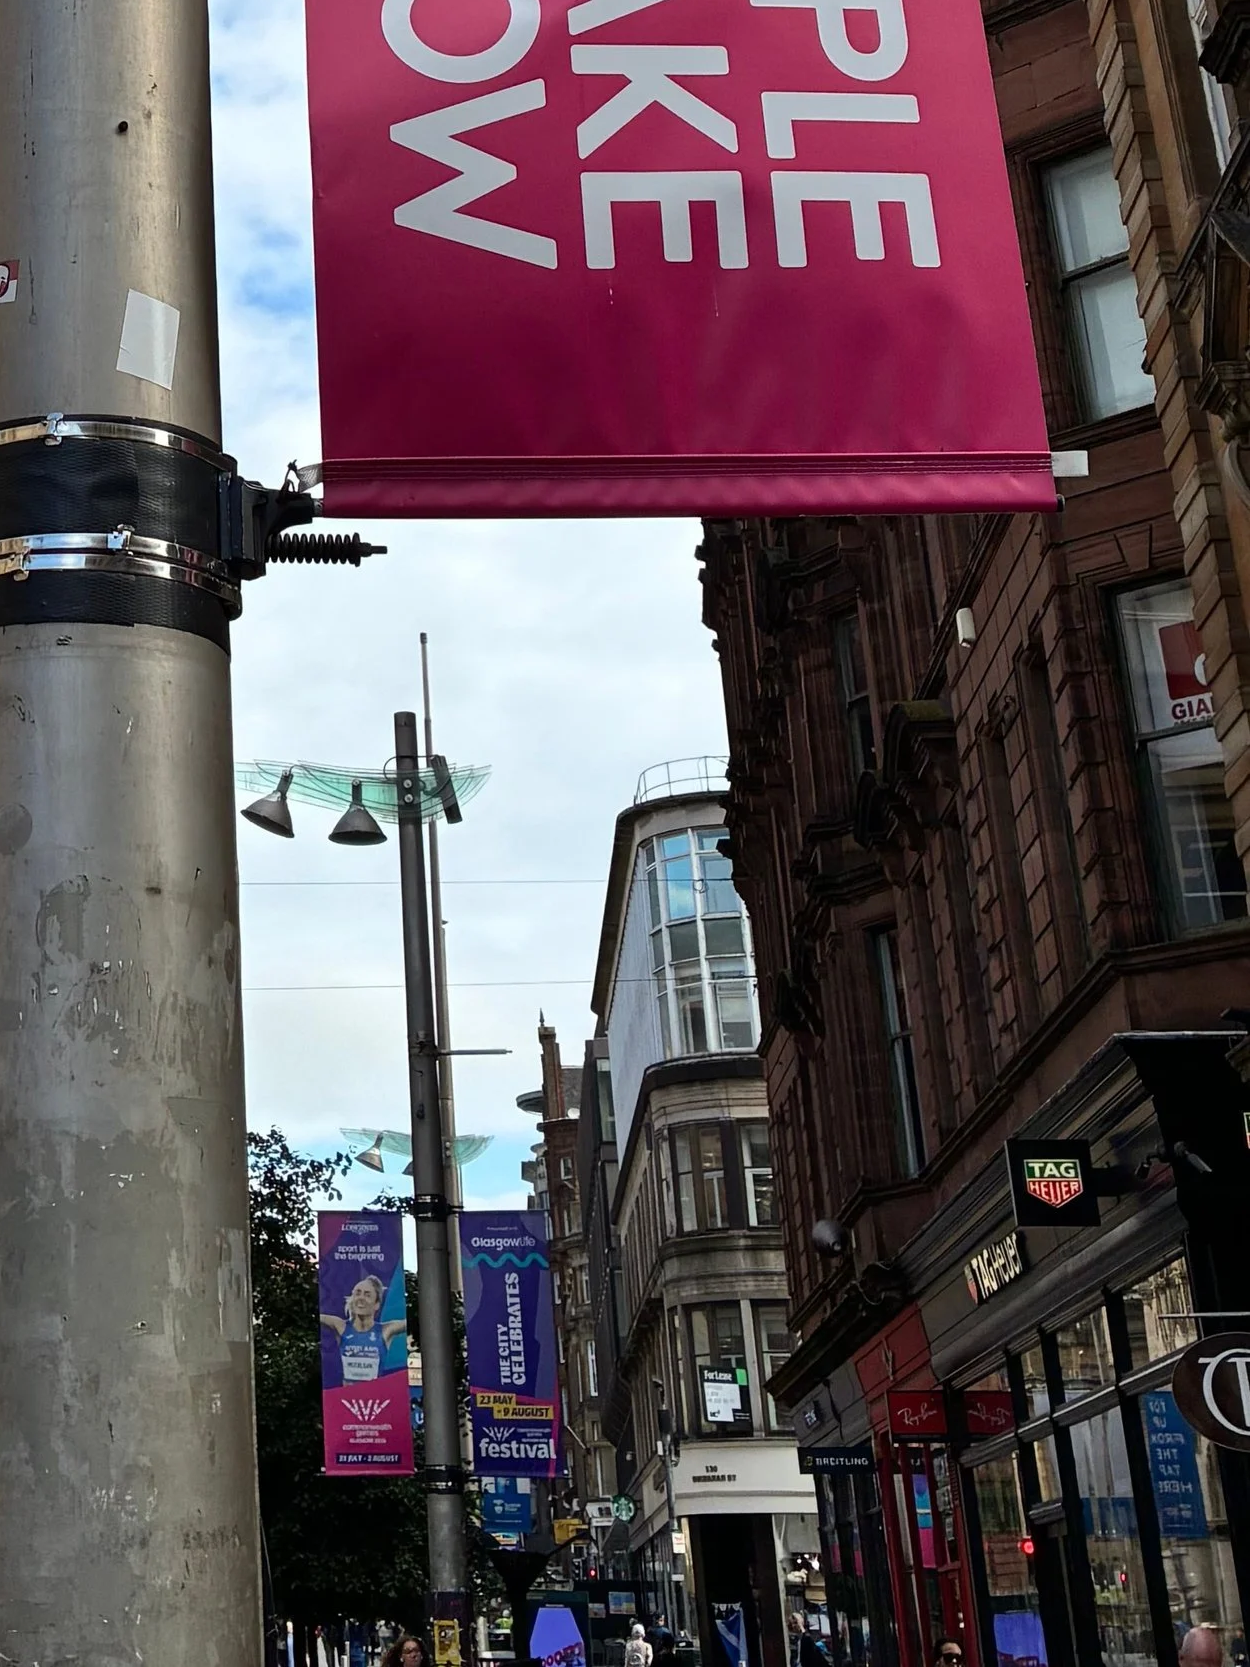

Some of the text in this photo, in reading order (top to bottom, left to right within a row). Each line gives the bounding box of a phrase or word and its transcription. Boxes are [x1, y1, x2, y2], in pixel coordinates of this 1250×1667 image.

[1027, 1162, 1076, 1178] TAG
[1029, 1181, 1079, 1205] HEUER
[505, 1271, 527, 1386] CELEBRATES
[497, 1324, 512, 1385] THE CITY
[479, 1395, 514, 1405] 23 MAY
[503, 1408, 510, 1416] 9
[511, 1407, 551, 1417] AUGUST
[478, 1437, 557, 1460] festival
